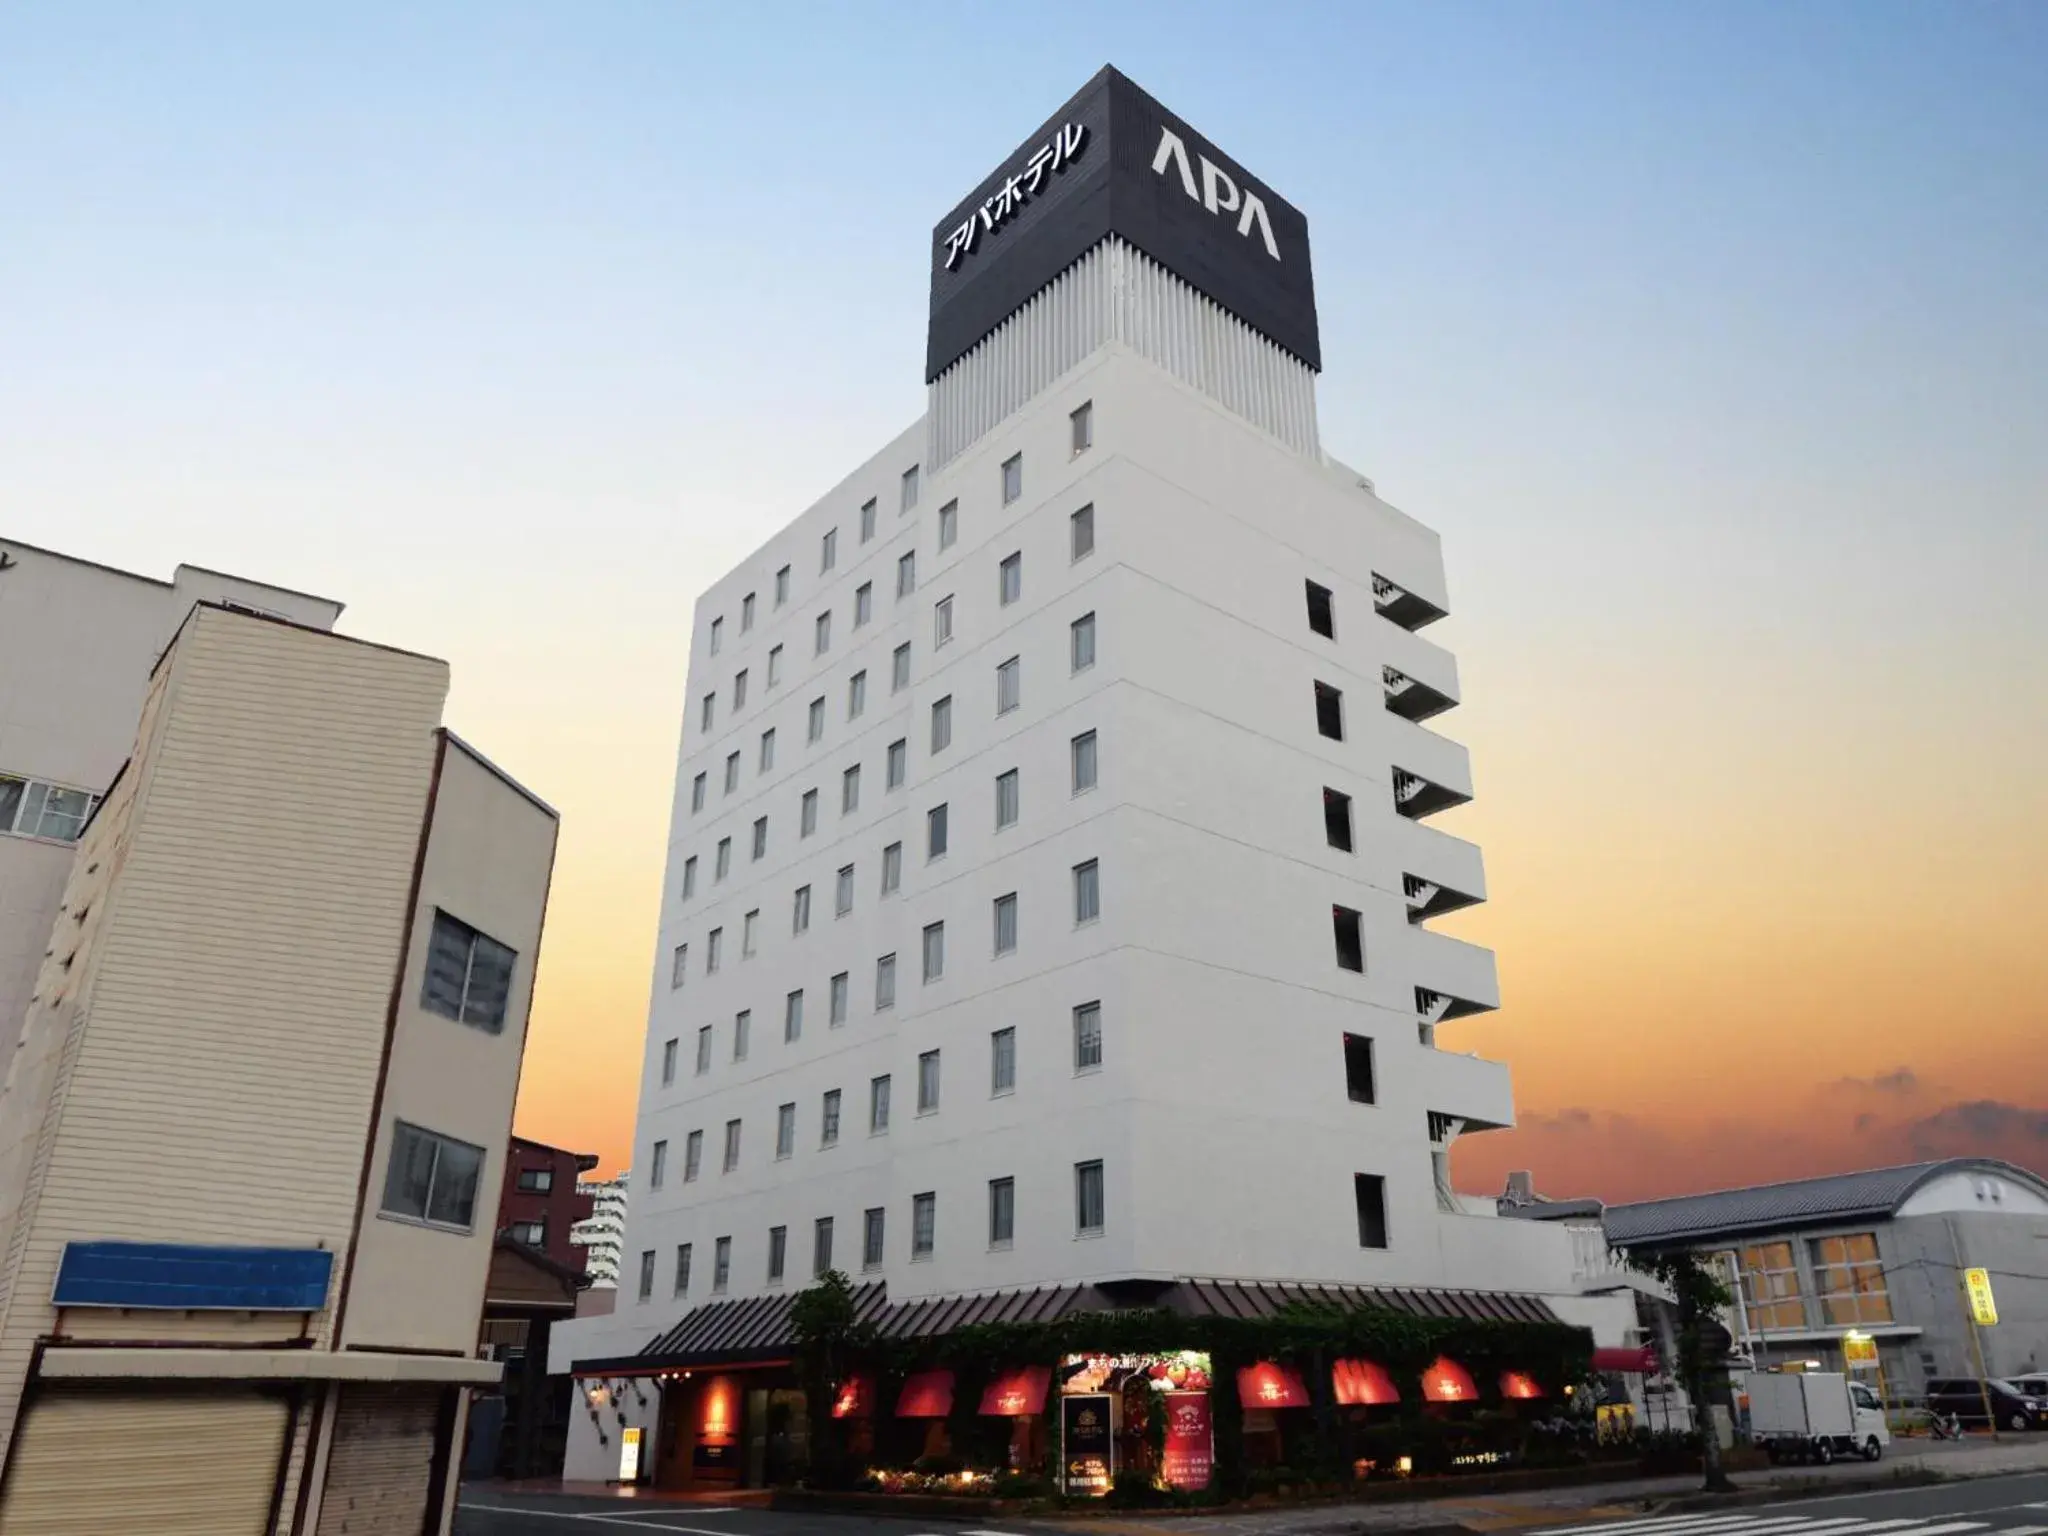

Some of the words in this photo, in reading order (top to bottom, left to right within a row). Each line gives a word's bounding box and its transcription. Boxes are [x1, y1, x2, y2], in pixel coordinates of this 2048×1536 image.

[944, 122, 1085, 269] アパホテル
[1151, 126, 1281, 261] APA
